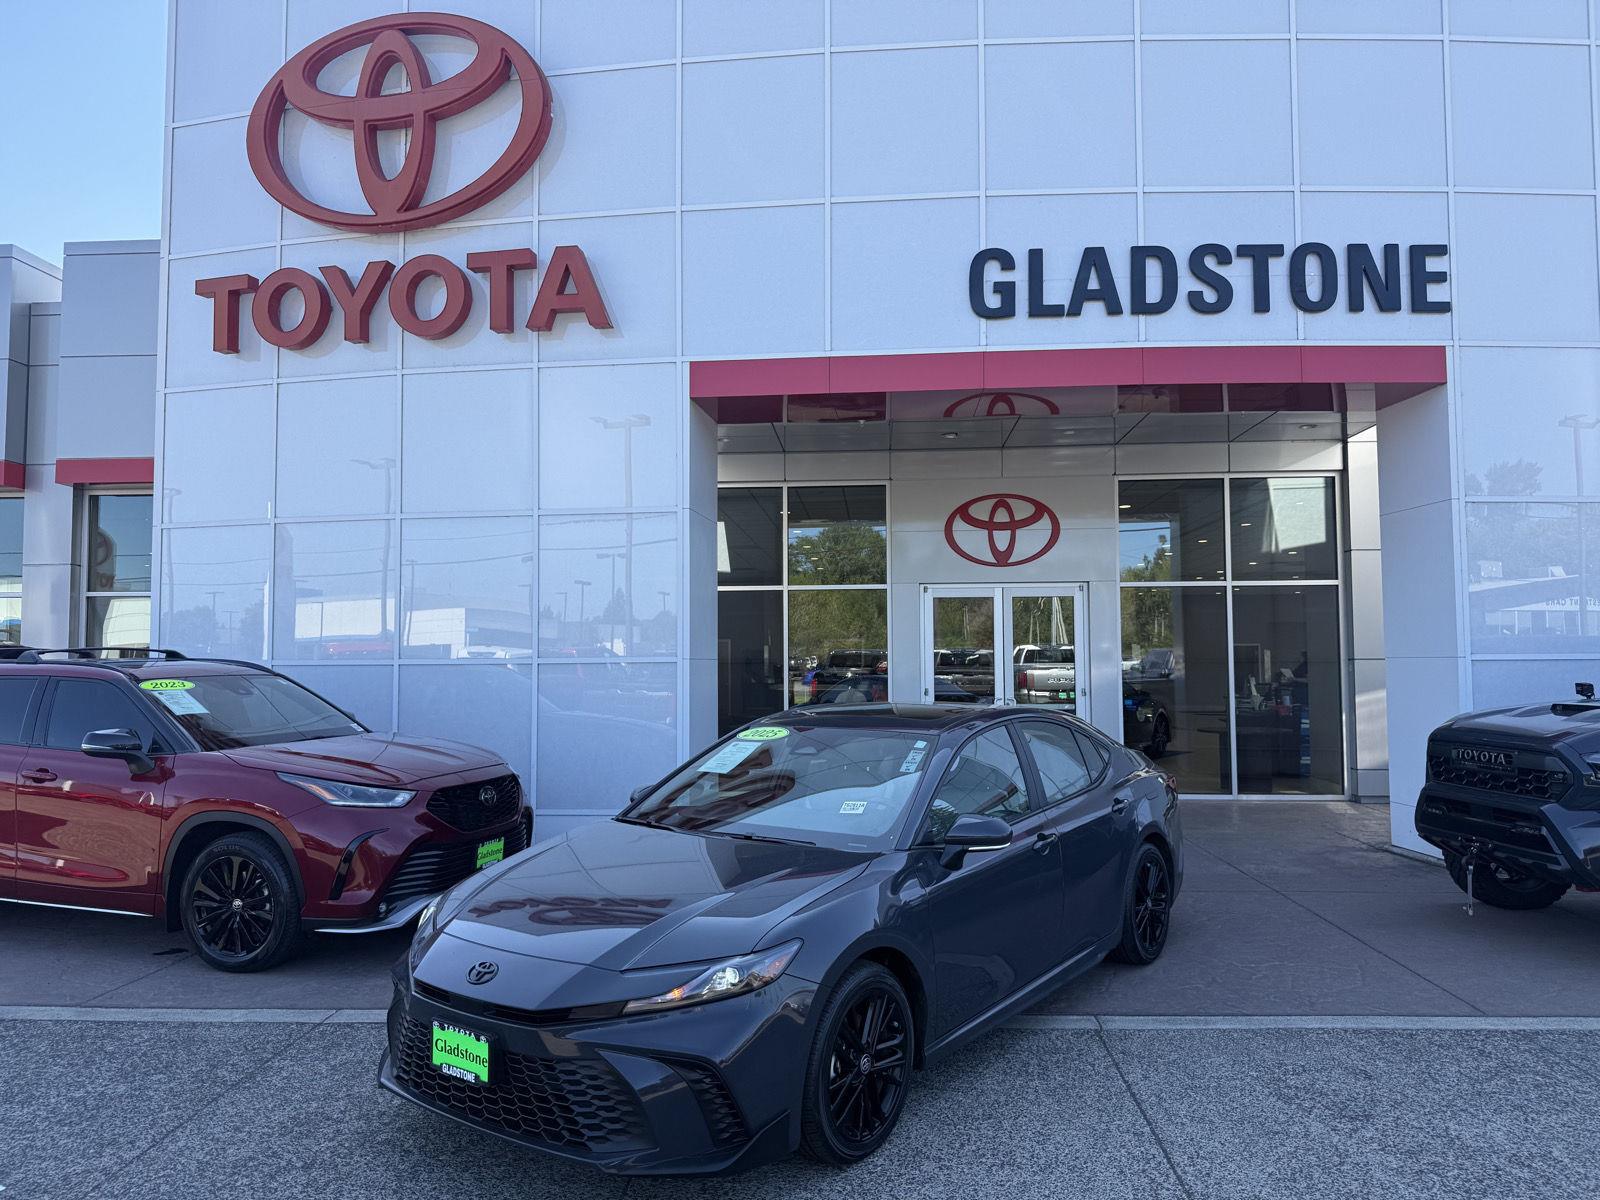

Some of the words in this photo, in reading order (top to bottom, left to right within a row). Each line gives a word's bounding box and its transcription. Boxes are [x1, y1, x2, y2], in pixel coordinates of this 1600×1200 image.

[969, 242, 1452, 319] GLADSTONE
[195, 245, 614, 355] TOYOTA
[150, 680, 187, 689] 2023
[1457, 748, 1506, 764] TOYOTA
[443, 1023, 476, 1040] TOYOTA
[434, 1038, 488, 1068] Gladstone
[441, 1063, 476, 1083] GLADSTONE
